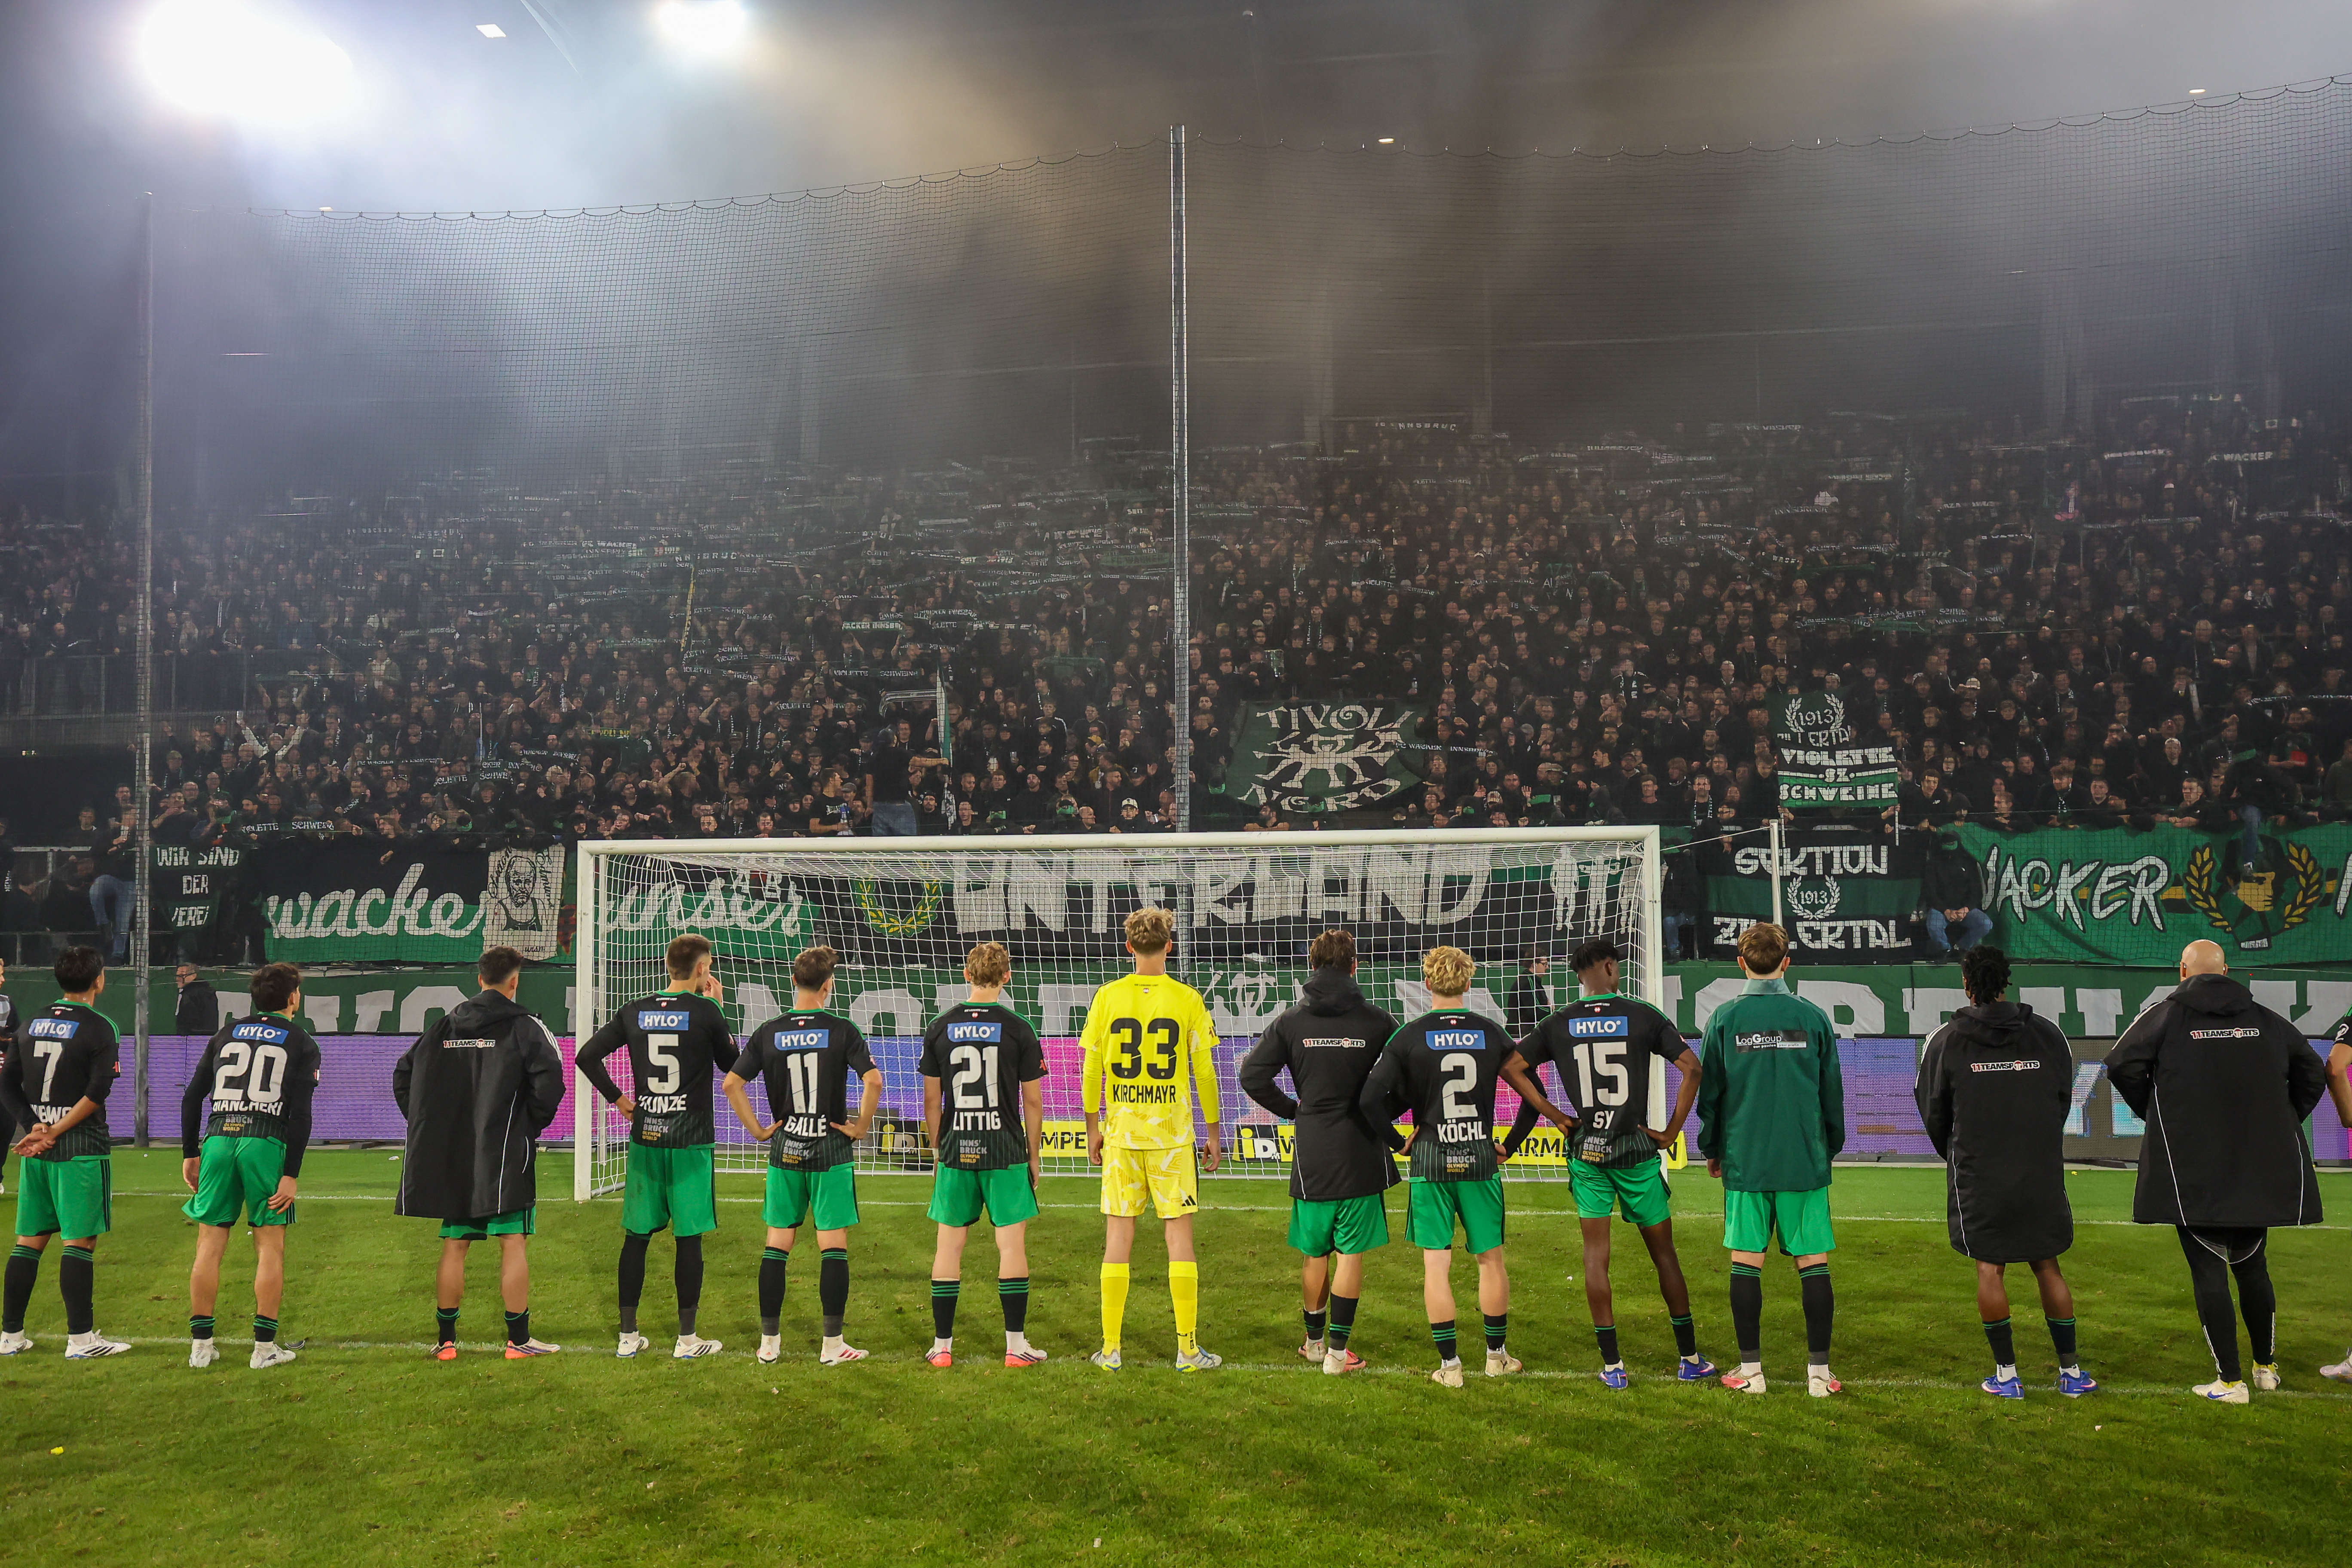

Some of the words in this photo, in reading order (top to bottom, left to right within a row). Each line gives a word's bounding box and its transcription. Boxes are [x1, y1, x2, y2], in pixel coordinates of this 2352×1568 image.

[1798, 709, 1834, 726] 1913
[1780, 747, 1896, 766] VIOLETTE
[1779, 783, 1898, 801] SCHWEINE
[182, 874, 208, 895] DER
[1799, 890, 1828, 905] 1913
[1110, 1017, 1180, 1080] 33
[1735, 1033, 1782, 1045] LogGroup
[34, 1041, 63, 1102] 7
[212, 1041, 288, 1103] 20
[647, 1033, 680, 1094] 5
[786, 1052, 818, 1114] 11
[949, 1045, 998, 1109] 21
[1573, 1041, 1629, 1108] 15
[1112, 1084, 1176, 1104] KIRCHMAYR
[1440, 1053, 1479, 1120] 2
[643, 1124, 668, 1133] BRUCK
[784, 1114, 827, 1138] GALLÉ
[952, 1110, 1001, 1131] LITTIG
[1592, 1110, 1615, 1130] SY
[1437, 1119, 1487, 1144] KÖCHL
[783, 1146, 810, 1158] BRUCK
[959, 1146, 988, 1155] BRUCK
[1582, 1149, 1605, 1158] OLYMPIA
[1583, 1142, 1612, 1154] BRUCK
[1446, 1155, 1476, 1164] BRUCK
[1581, 1155, 1600, 1163] WORLD
